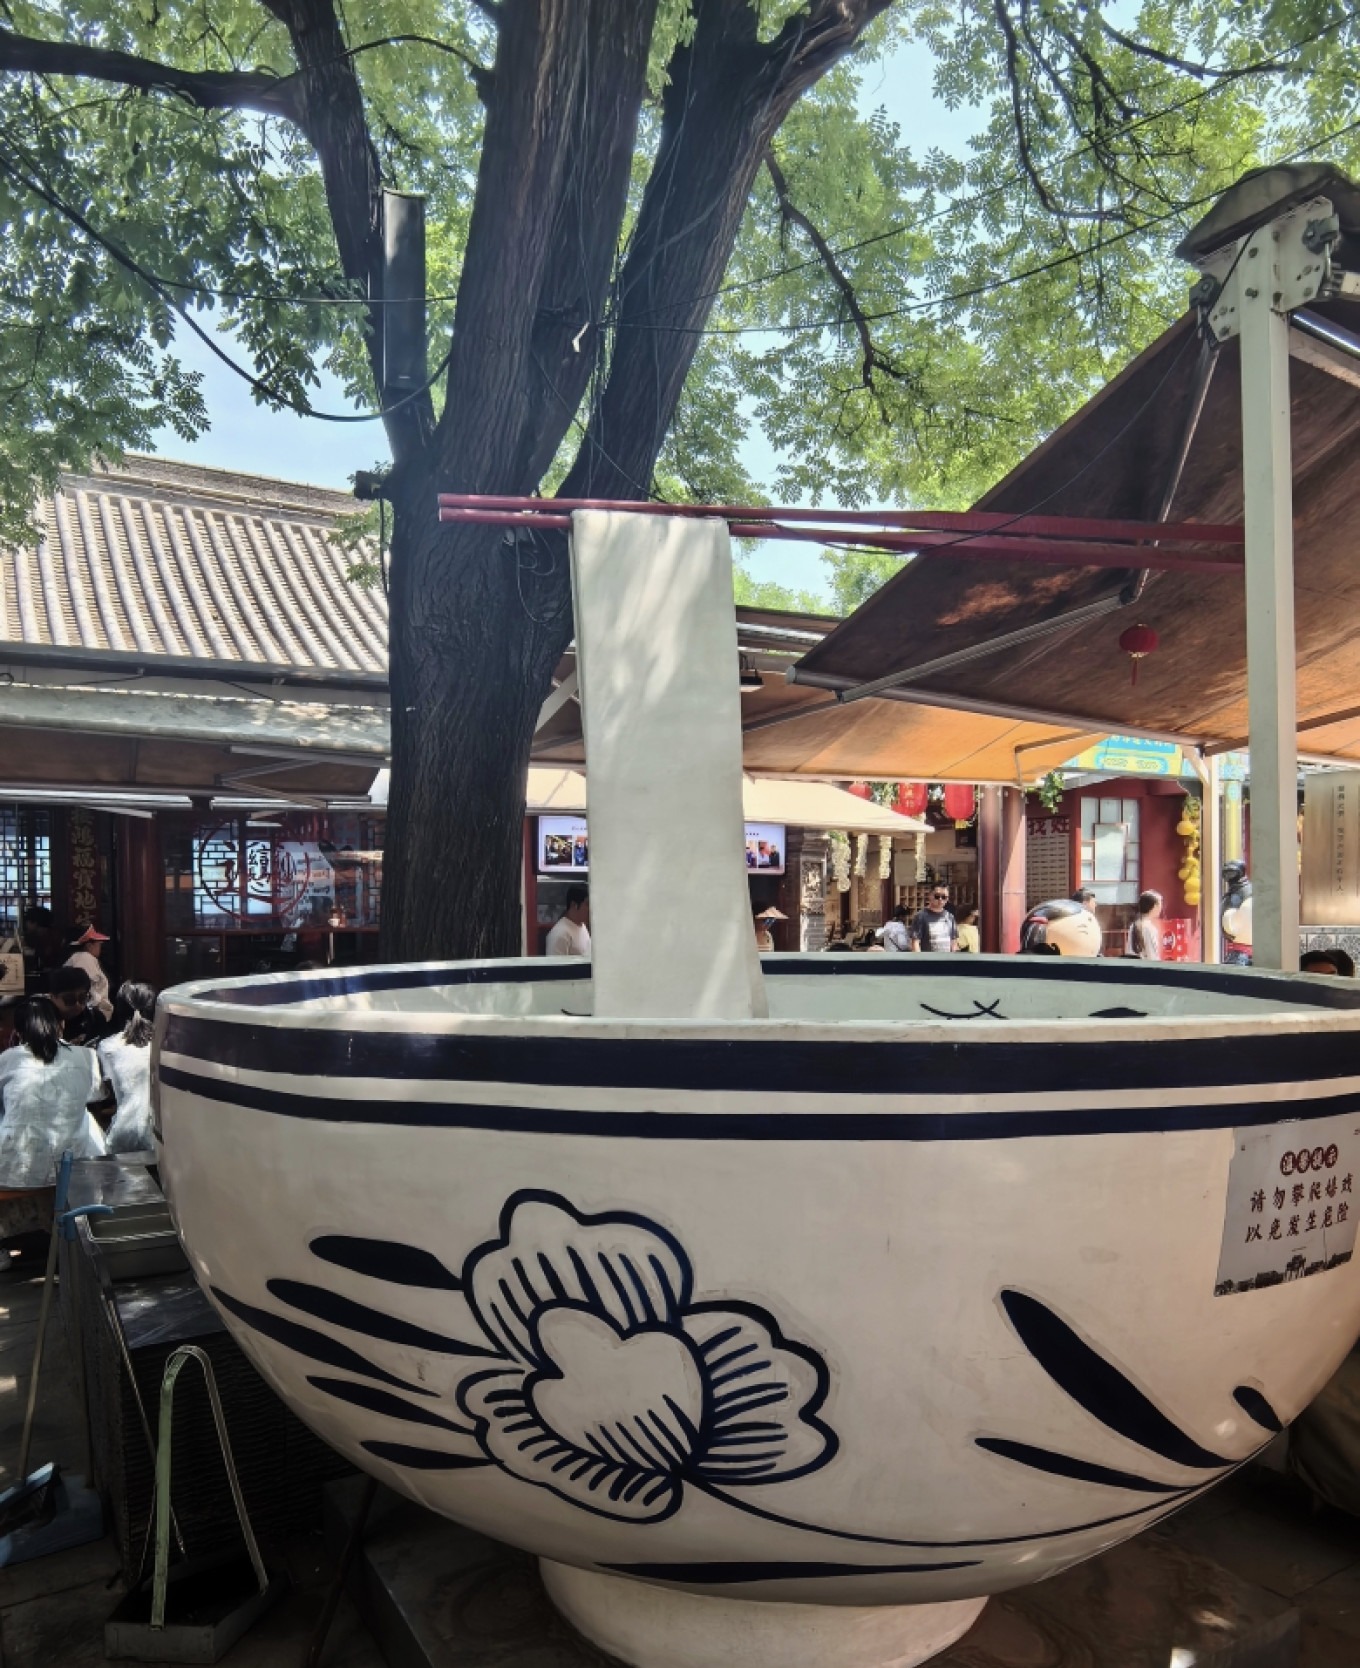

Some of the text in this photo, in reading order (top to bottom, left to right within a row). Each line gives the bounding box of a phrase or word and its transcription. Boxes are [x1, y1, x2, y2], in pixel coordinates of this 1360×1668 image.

[1244, 1201, 1349, 1243] 以免发生危险
